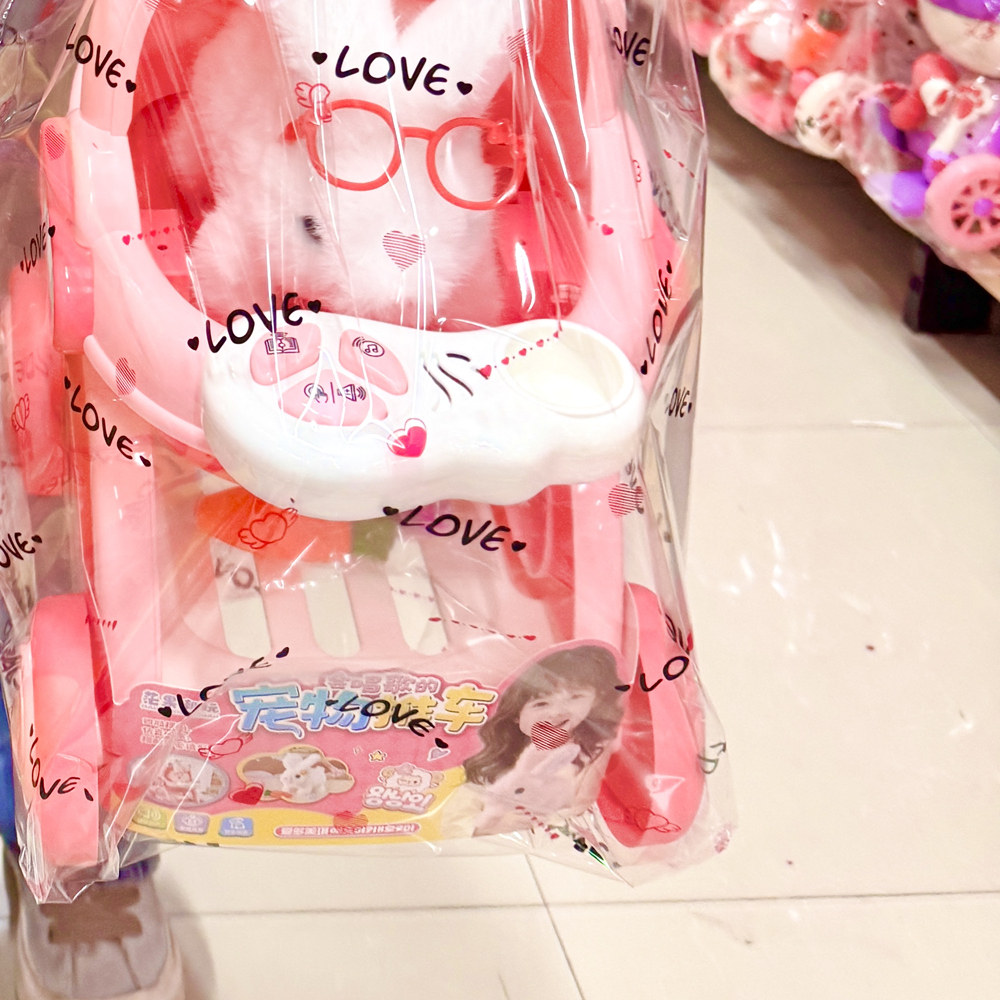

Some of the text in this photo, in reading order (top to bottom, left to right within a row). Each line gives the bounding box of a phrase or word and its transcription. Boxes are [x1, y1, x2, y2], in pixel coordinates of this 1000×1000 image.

[66, 23, 126, 88] LOVE
[335, 45, 451, 96] LOVE
[24, 221, 47, 275] LOVE
[203, 292, 303, 353] LOVE
[69, 384, 134, 460] LOVE
[398, 504, 509, 552] LOVE
[339, 695, 436, 737] LOVE
